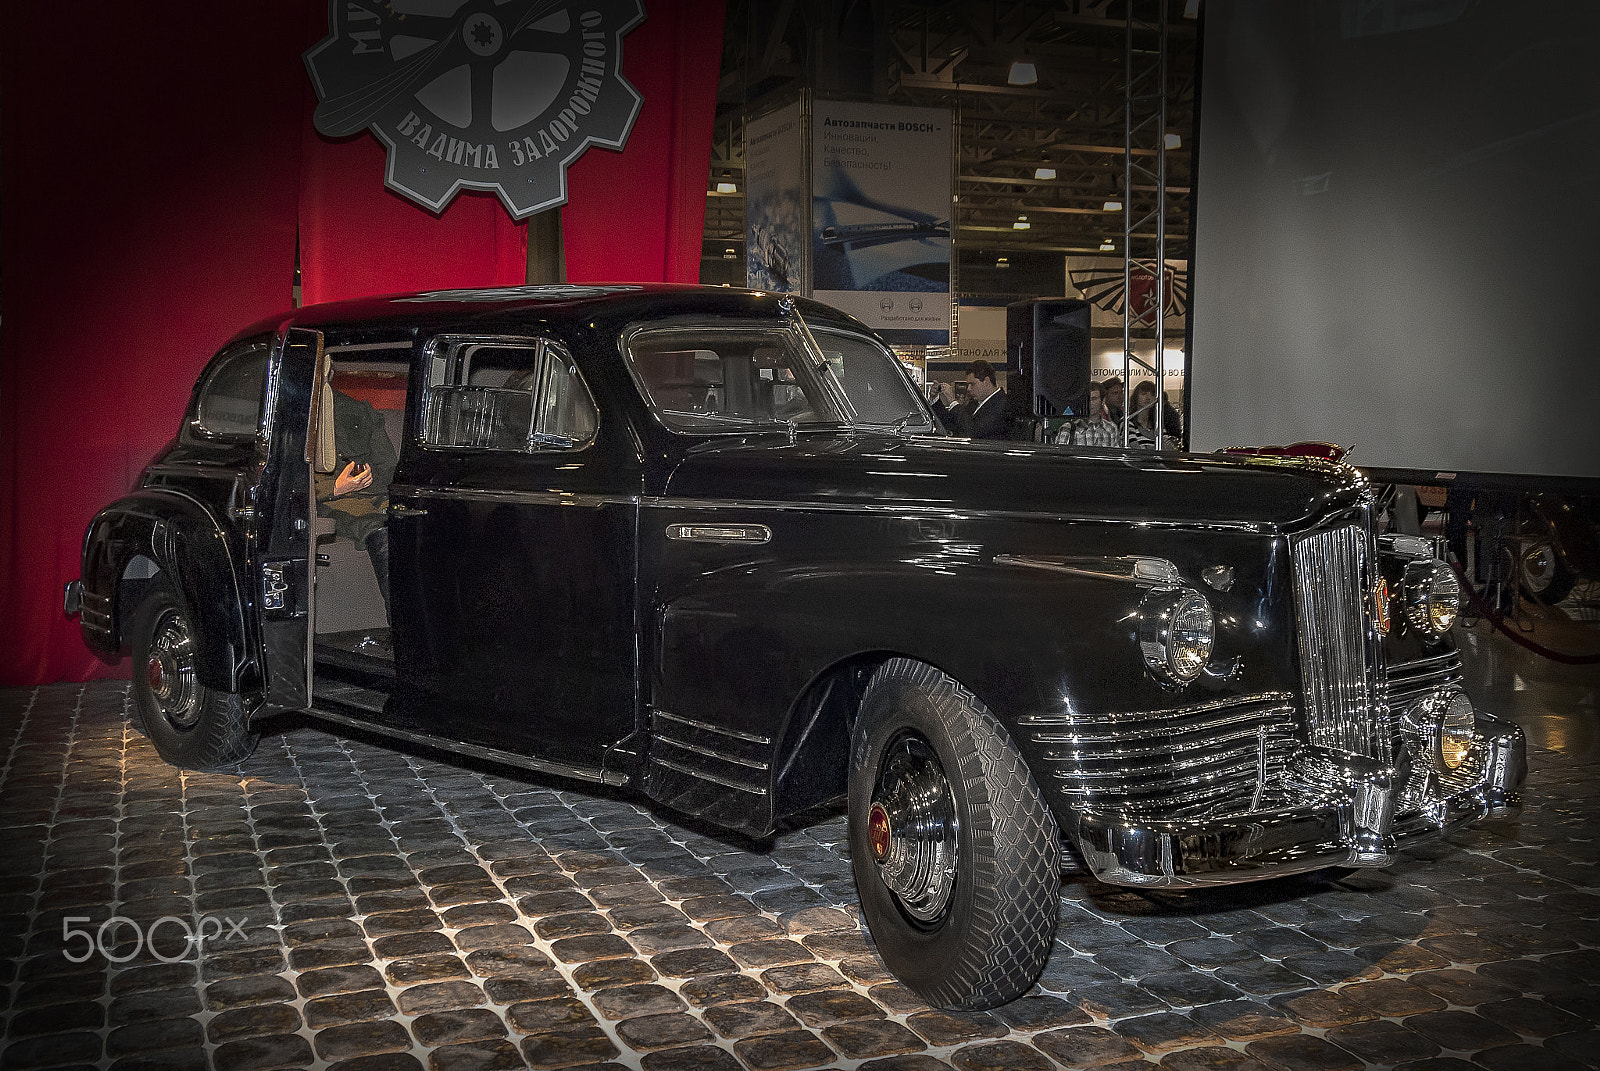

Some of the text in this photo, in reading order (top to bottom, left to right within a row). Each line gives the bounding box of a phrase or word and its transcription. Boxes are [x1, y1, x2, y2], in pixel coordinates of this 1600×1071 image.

[395, 10, 607, 169] ВАДИМА ЗАДОРОЖНОГО
[823, 116, 896, 130] Автозапчасти
[898, 121, 934, 132] BOSCH
[823, 131, 879, 144] Инновации,
[823, 144, 870, 157] Качество,
[823, 157, 892, 170] Безопасность!
[982, 347, 1000, 357] для
